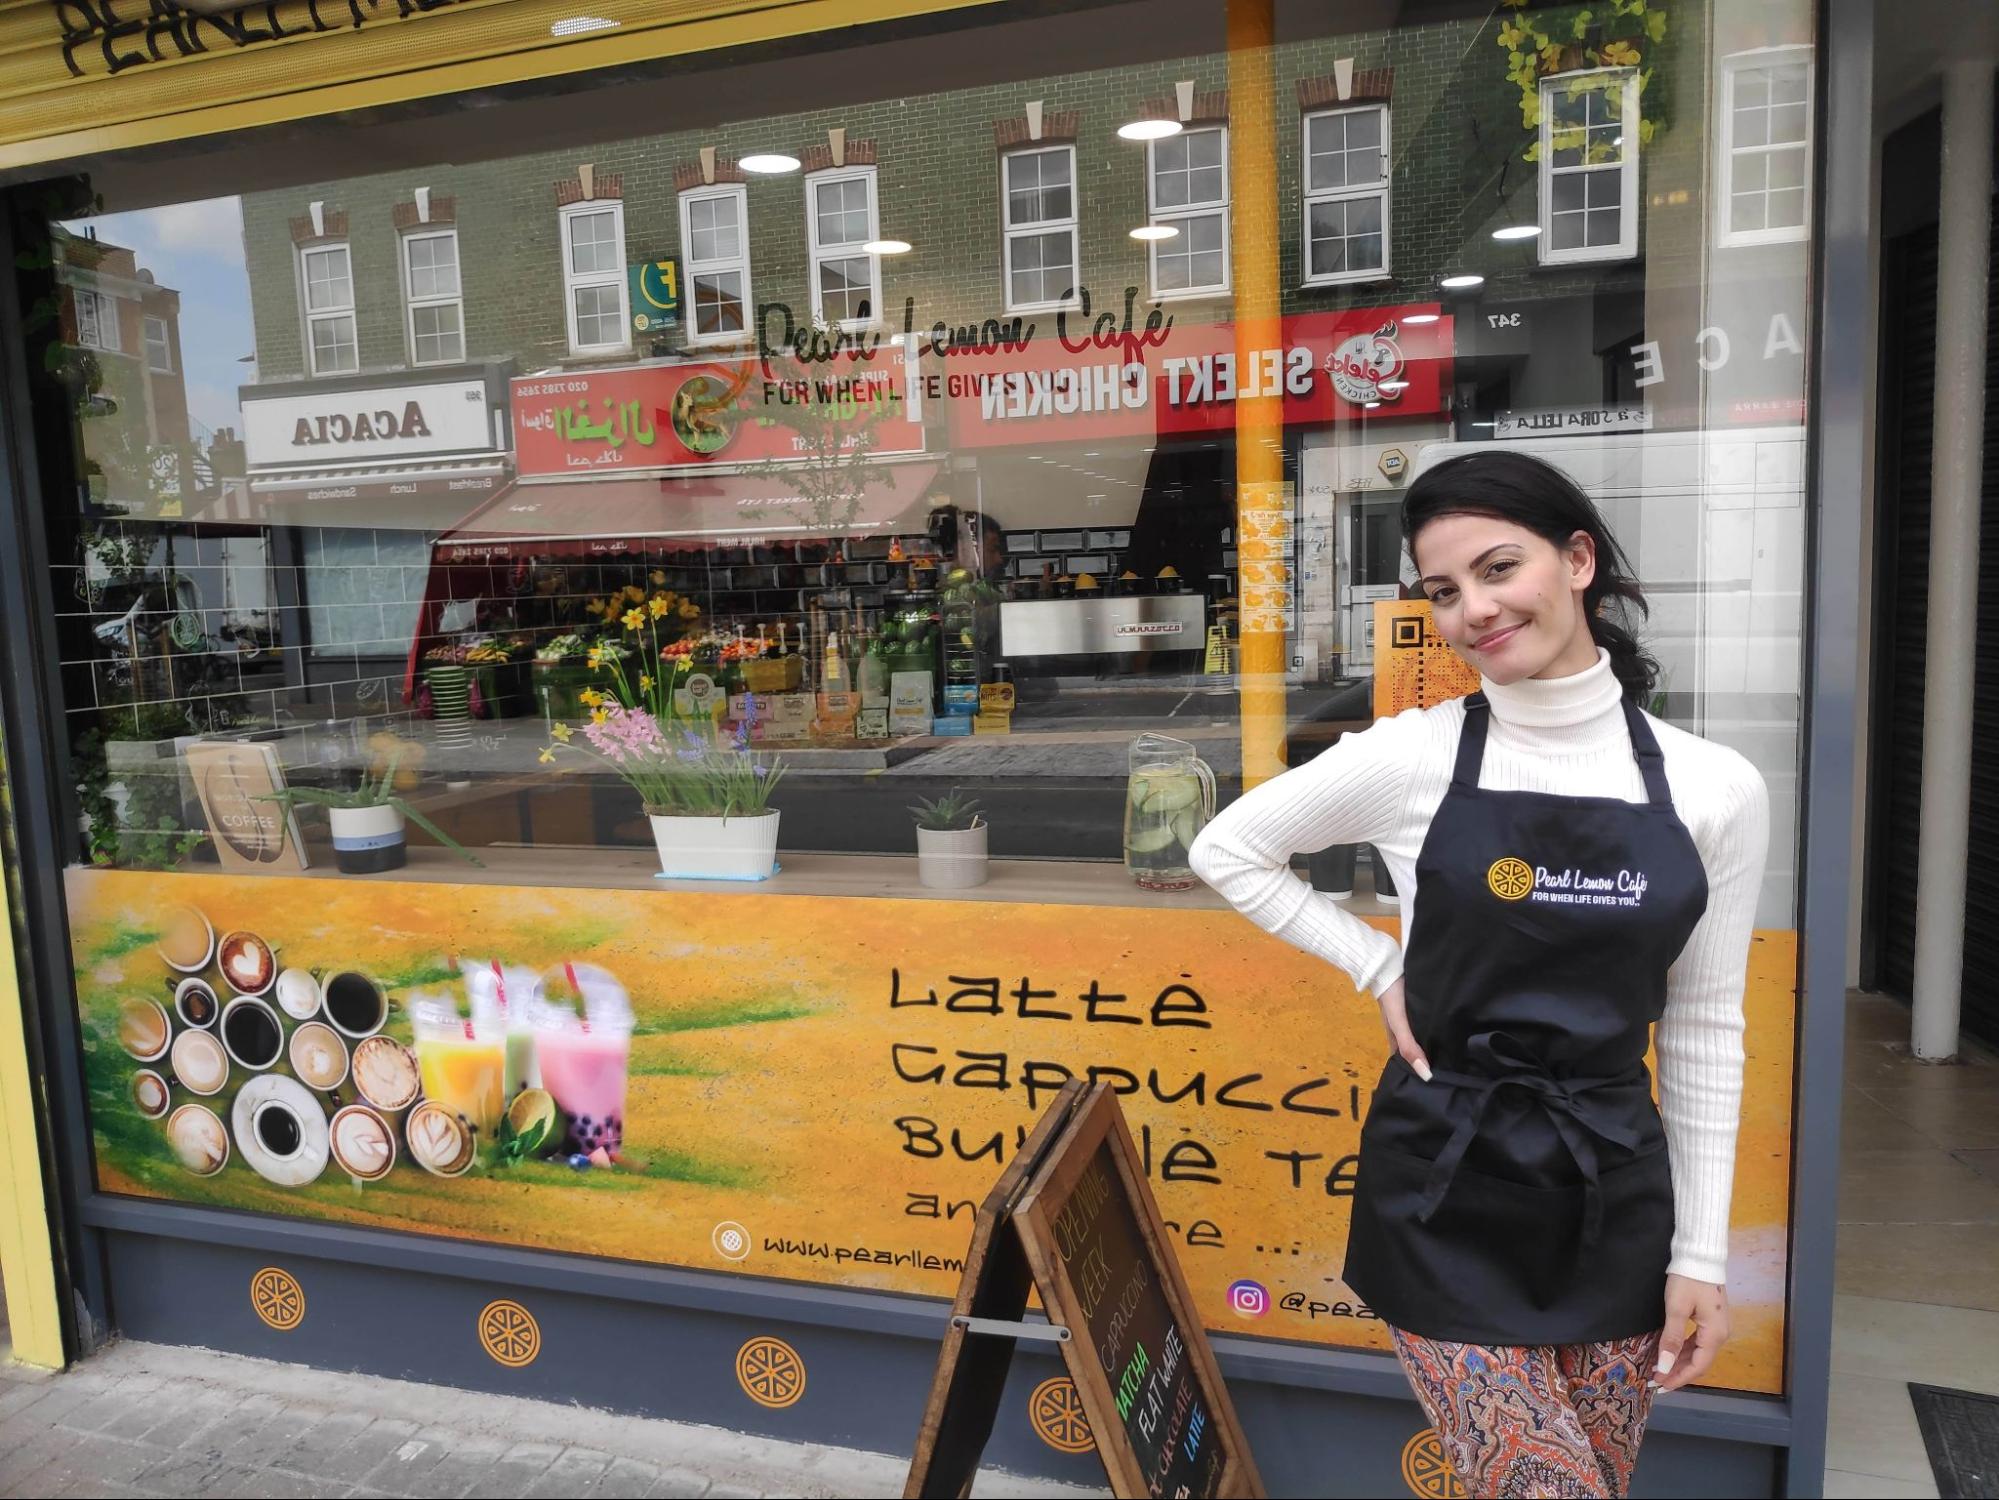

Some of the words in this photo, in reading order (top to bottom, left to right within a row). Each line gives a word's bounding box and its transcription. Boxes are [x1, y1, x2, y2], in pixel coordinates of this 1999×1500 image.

[757, 300, 881, 380] Pearl
[903, 297, 1036, 361] Lemon
[1056, 286, 1174, 388] Café
[763, 377, 809, 406] FOR
[814, 375, 884, 405] WHEN
[221, 815, 276, 828] COFFEE
[1532, 891, 1549, 902] FOR
[1549, 893, 1575, 903] WHEN
[1575, 894, 1592, 904] LIFE
[1593, 895, 1616, 905] GIVES
[1535, 866, 1571, 888] Pearl
[1574, 869, 1615, 891] Lemon
[1617, 870, 1648, 900] Café
[890, 967, 1212, 1029] Latte
[892, 1042, 1377, 1121] Cappucci
[894, 1115, 1223, 1187] Bule
[1265, 1150, 1359, 1197] Te
[905, 1191, 977, 1221] an
[764, 1237, 967, 1275] www.pearllem
[1279, 1292, 1379, 1320] @pea
[1138, 1373, 1164, 1443] FLAT
[1183, 1401, 1205, 1462] LATTE
